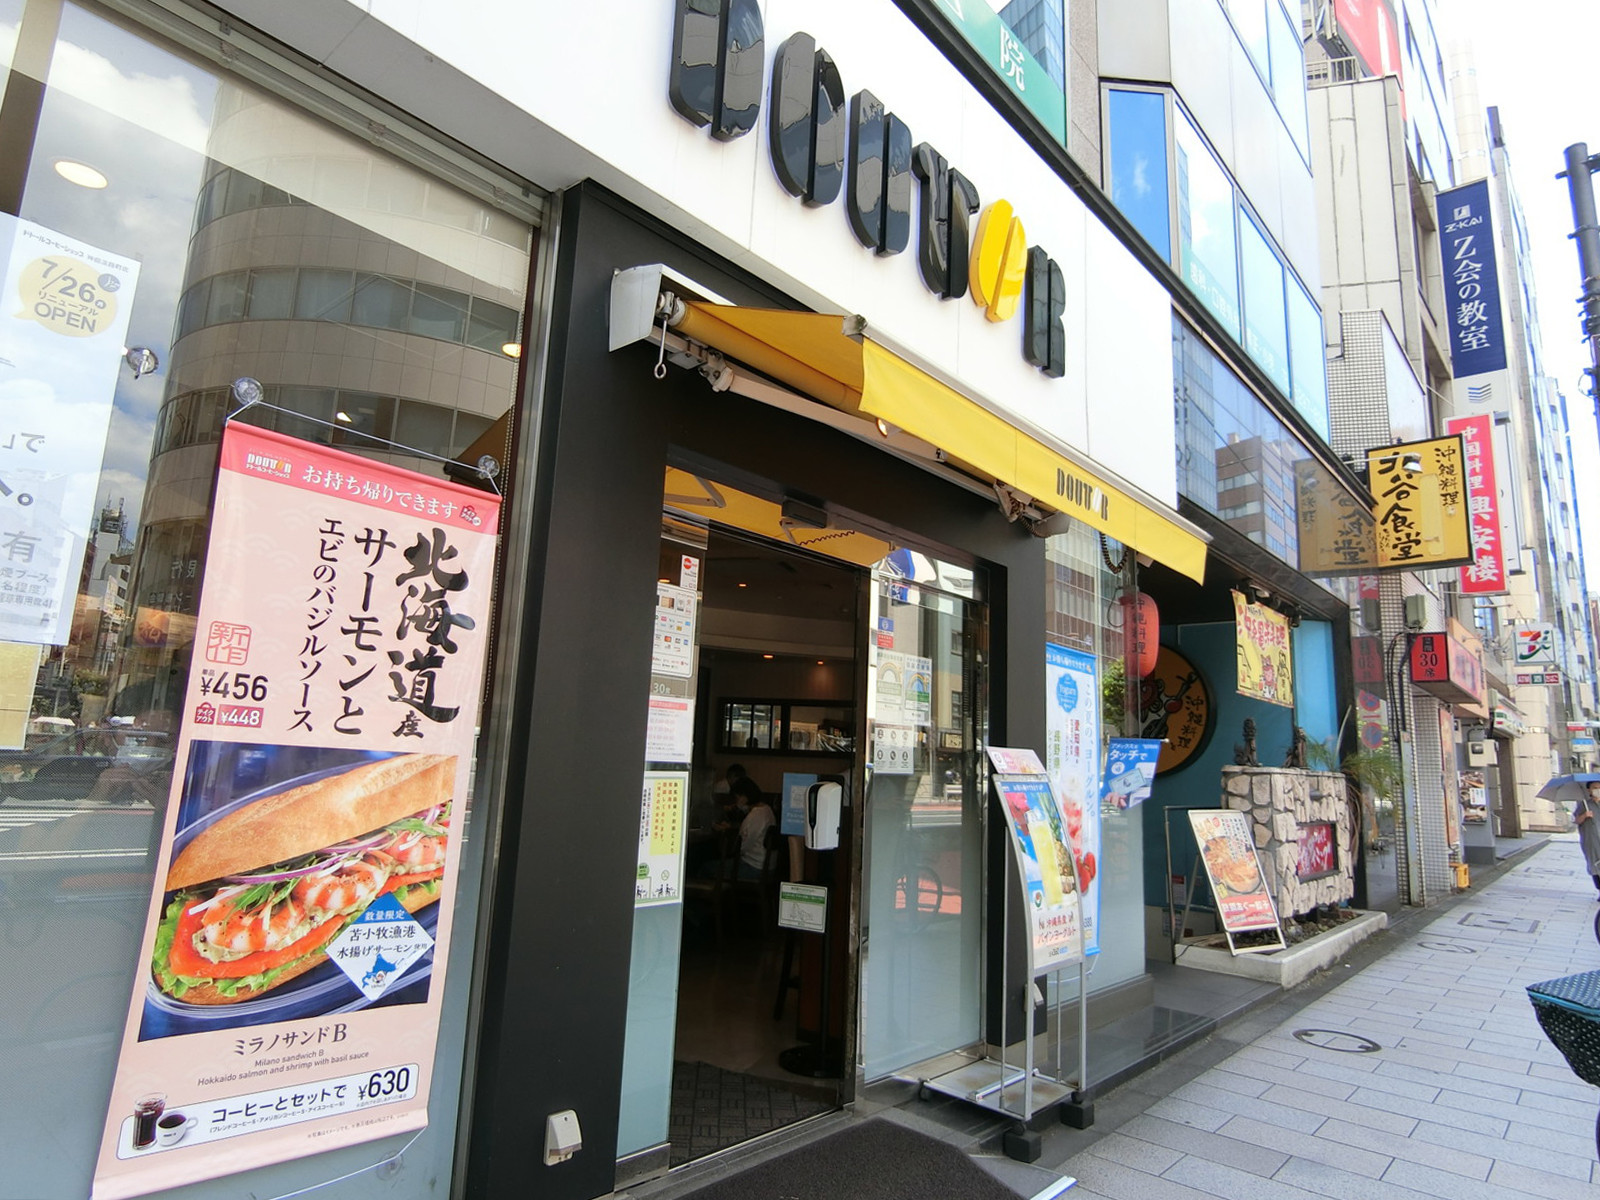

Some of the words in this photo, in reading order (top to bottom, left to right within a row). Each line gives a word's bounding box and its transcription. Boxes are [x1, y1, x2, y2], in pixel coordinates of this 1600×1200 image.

[669, 0, 1067, 379] DOUTOR
[1444, 215, 1483, 234] Z-KAI
[34, 301, 97, 333] OPEN
[38, 290, 99, 316] リニューアル
[302, 465, 458, 518] お持ち帰りできます
[1434, 445, 1460, 507] 沖縄料理
[1056, 467, 1109, 521] DOUTOR
[2, 530, 43, 563] 有
[286, 518, 345, 732] エビのバジルソース
[333, 527, 397, 735] サーモンと
[206, 621, 252, 666] 新作
[1420, 653, 1438, 667] 30
[200, 671, 268, 702] ¥456
[220, 708, 261, 726] ¥448
[1110, 749, 1148, 761] タッチで
[364, 909, 405, 922] 数量限定
[349, 925, 416, 942] 苫小牧漁港
[197, 1073, 237, 1087] Hokkaido
[238, 1069, 268, 1080] salmon
[269, 1065, 285, 1075] and
[285, 1060, 313, 1072] shrimp
[314, 1057, 330, 1067] with
[330, 1054, 348, 1064] basil
[348, 1050, 370, 1061] sauce
[255, 1057, 281, 1068] Milano
[281, 1051, 317, 1063] sandwich
[317, 1049, 325, 1057] B
[211, 1084, 348, 1124] コーヒーとセットで
[358, 1067, 410, 1101] ¥630
